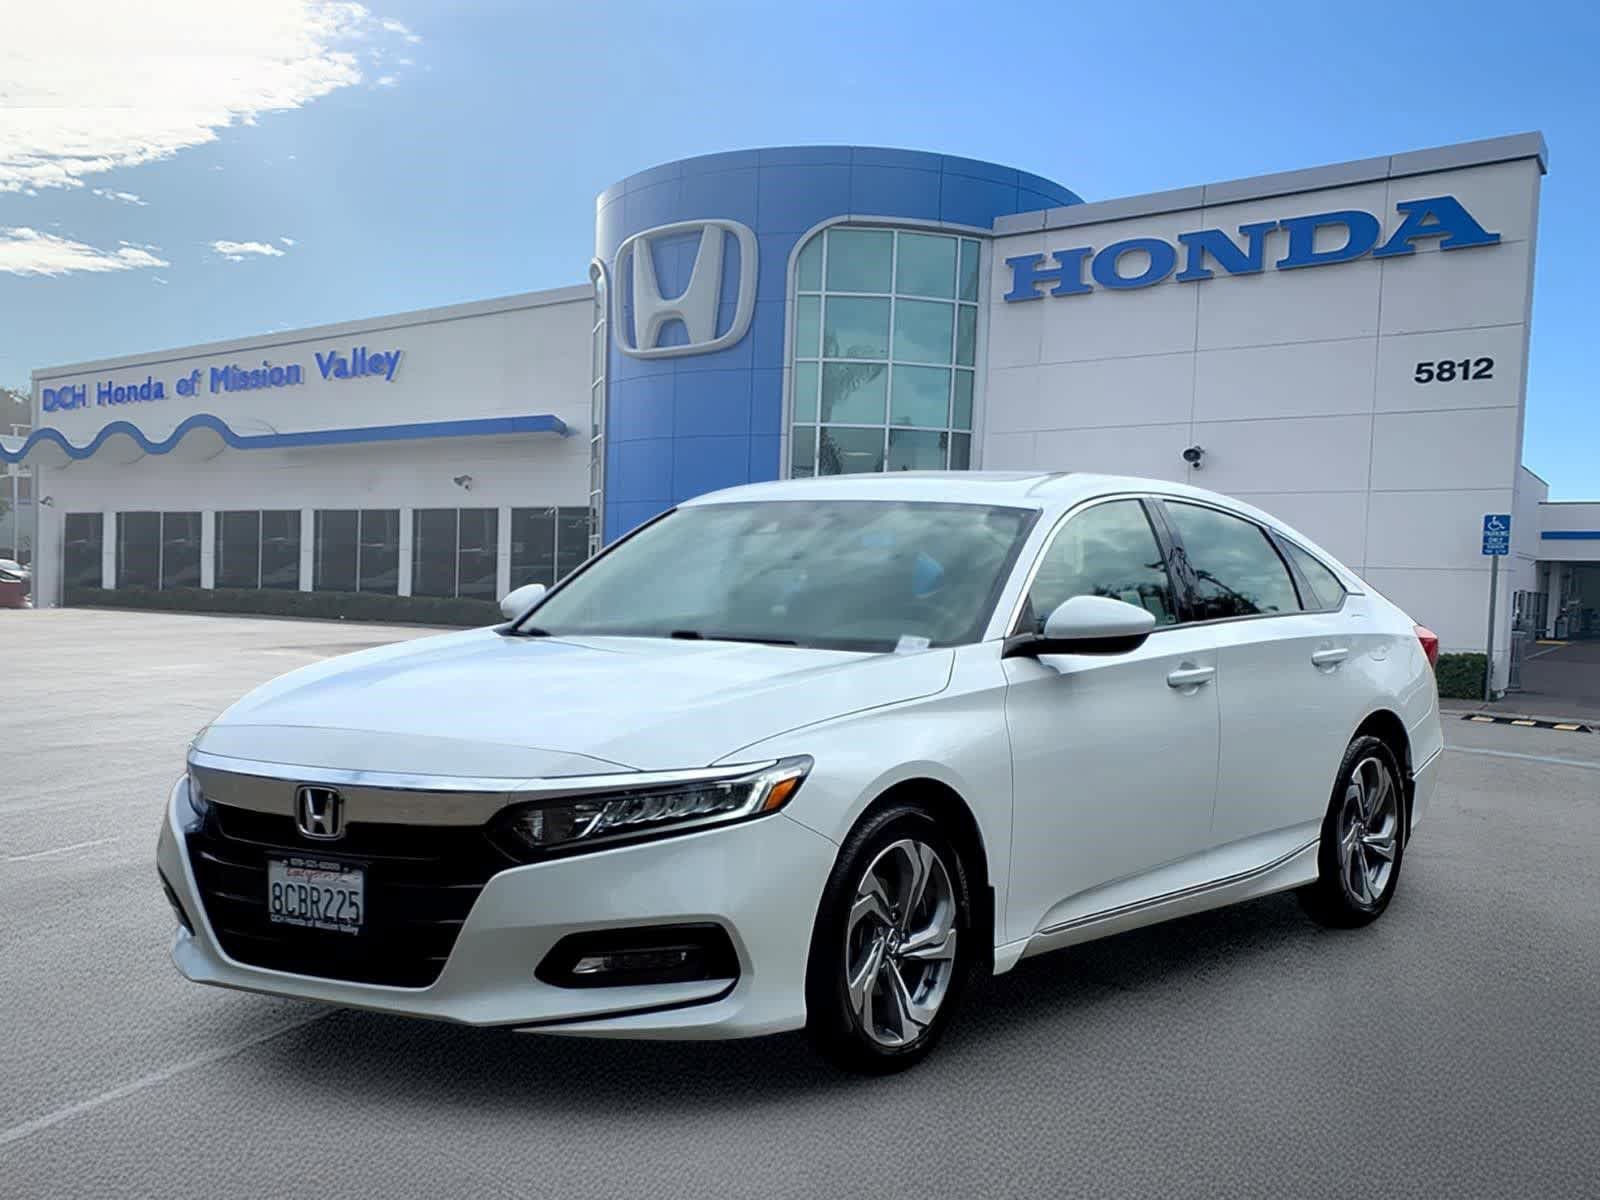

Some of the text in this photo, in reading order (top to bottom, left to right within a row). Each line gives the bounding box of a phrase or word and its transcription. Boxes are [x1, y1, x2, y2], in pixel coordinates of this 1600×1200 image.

[1003, 195, 1501, 303] HONDA
[42, 346, 404, 412] DCH Honda of Mission Valley
[1414, 357, 1494, 384] 5812
[272, 882, 361, 923] 8CBR225
